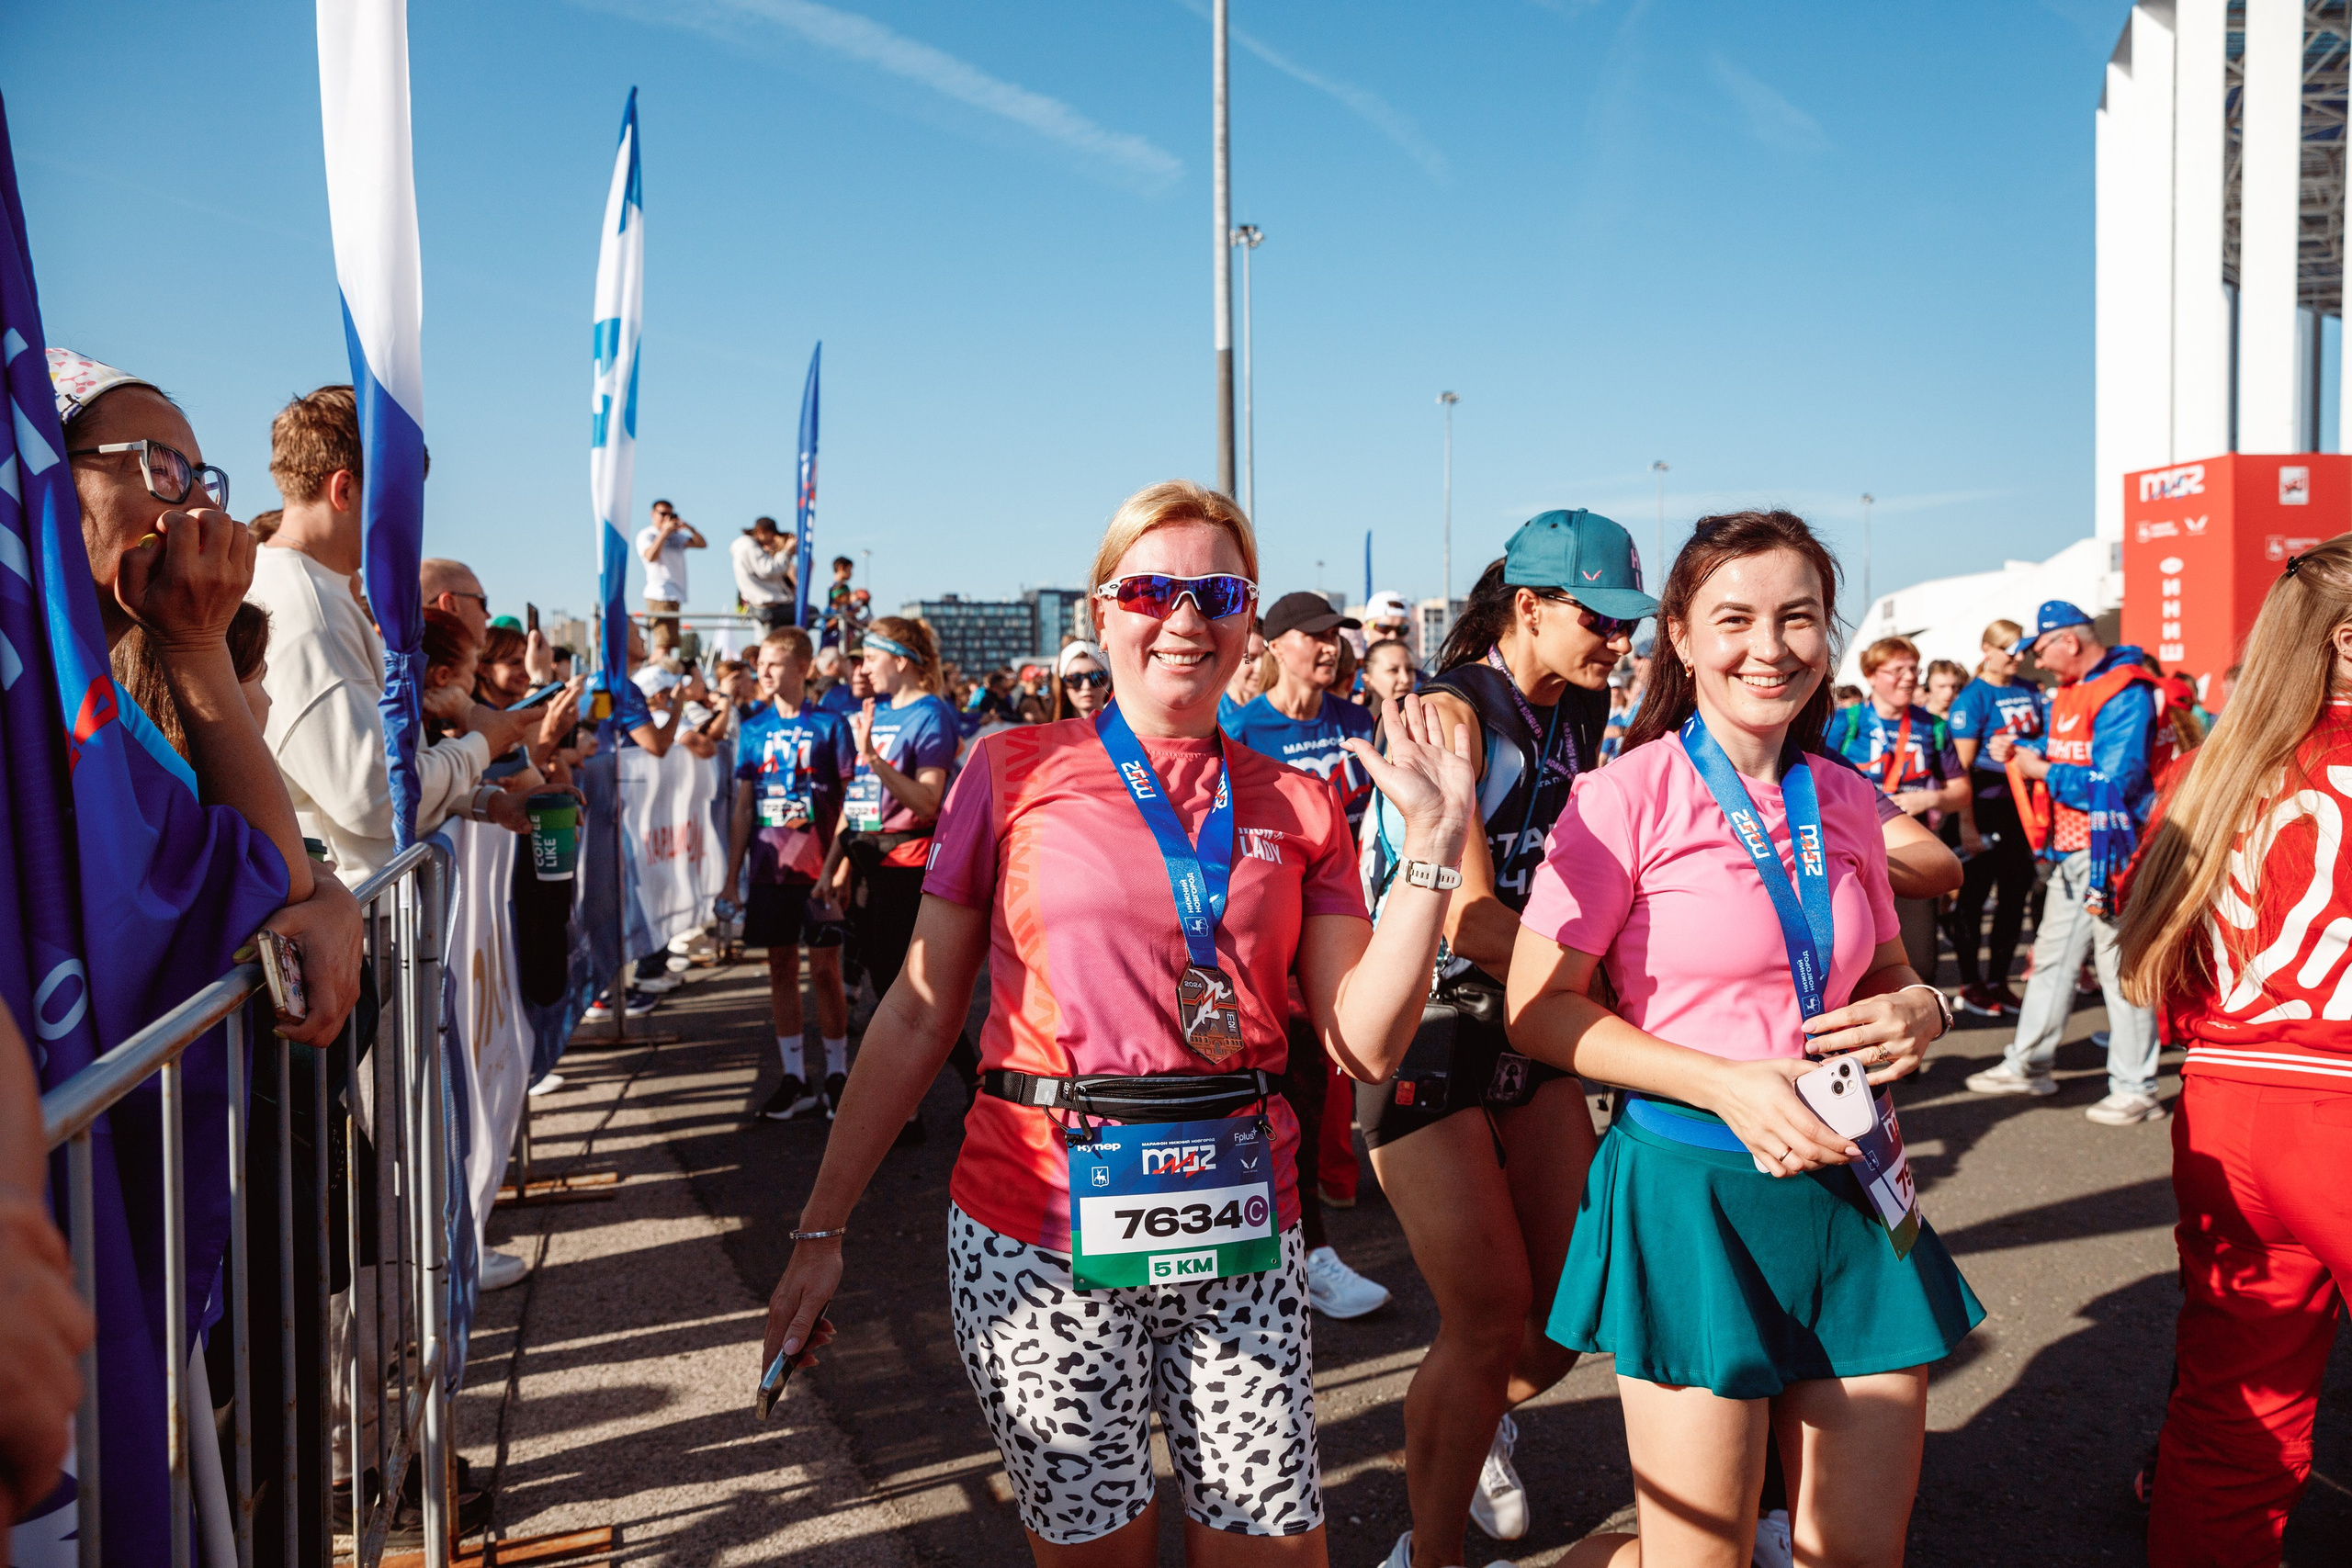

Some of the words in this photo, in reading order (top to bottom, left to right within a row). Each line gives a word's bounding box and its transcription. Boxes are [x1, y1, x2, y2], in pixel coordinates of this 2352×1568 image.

[544, 838, 558, 867] LIKE
[1239, 835, 1283, 864] LADY
[1180, 879, 1194, 913] НИЖНИЙ
[1186, 873, 1202, 913] НОВГОРОД
[1183, 980, 1202, 988] 2024
[1797, 959, 1808, 992] НИЖНИЙ
[1802, 950, 1815, 991] НОВГОРОД
[1895, 1156, 1912, 1200] 79
[1114, 1200, 1243, 1239] 7634
[1154, 1262, 1171, 1277] 5
